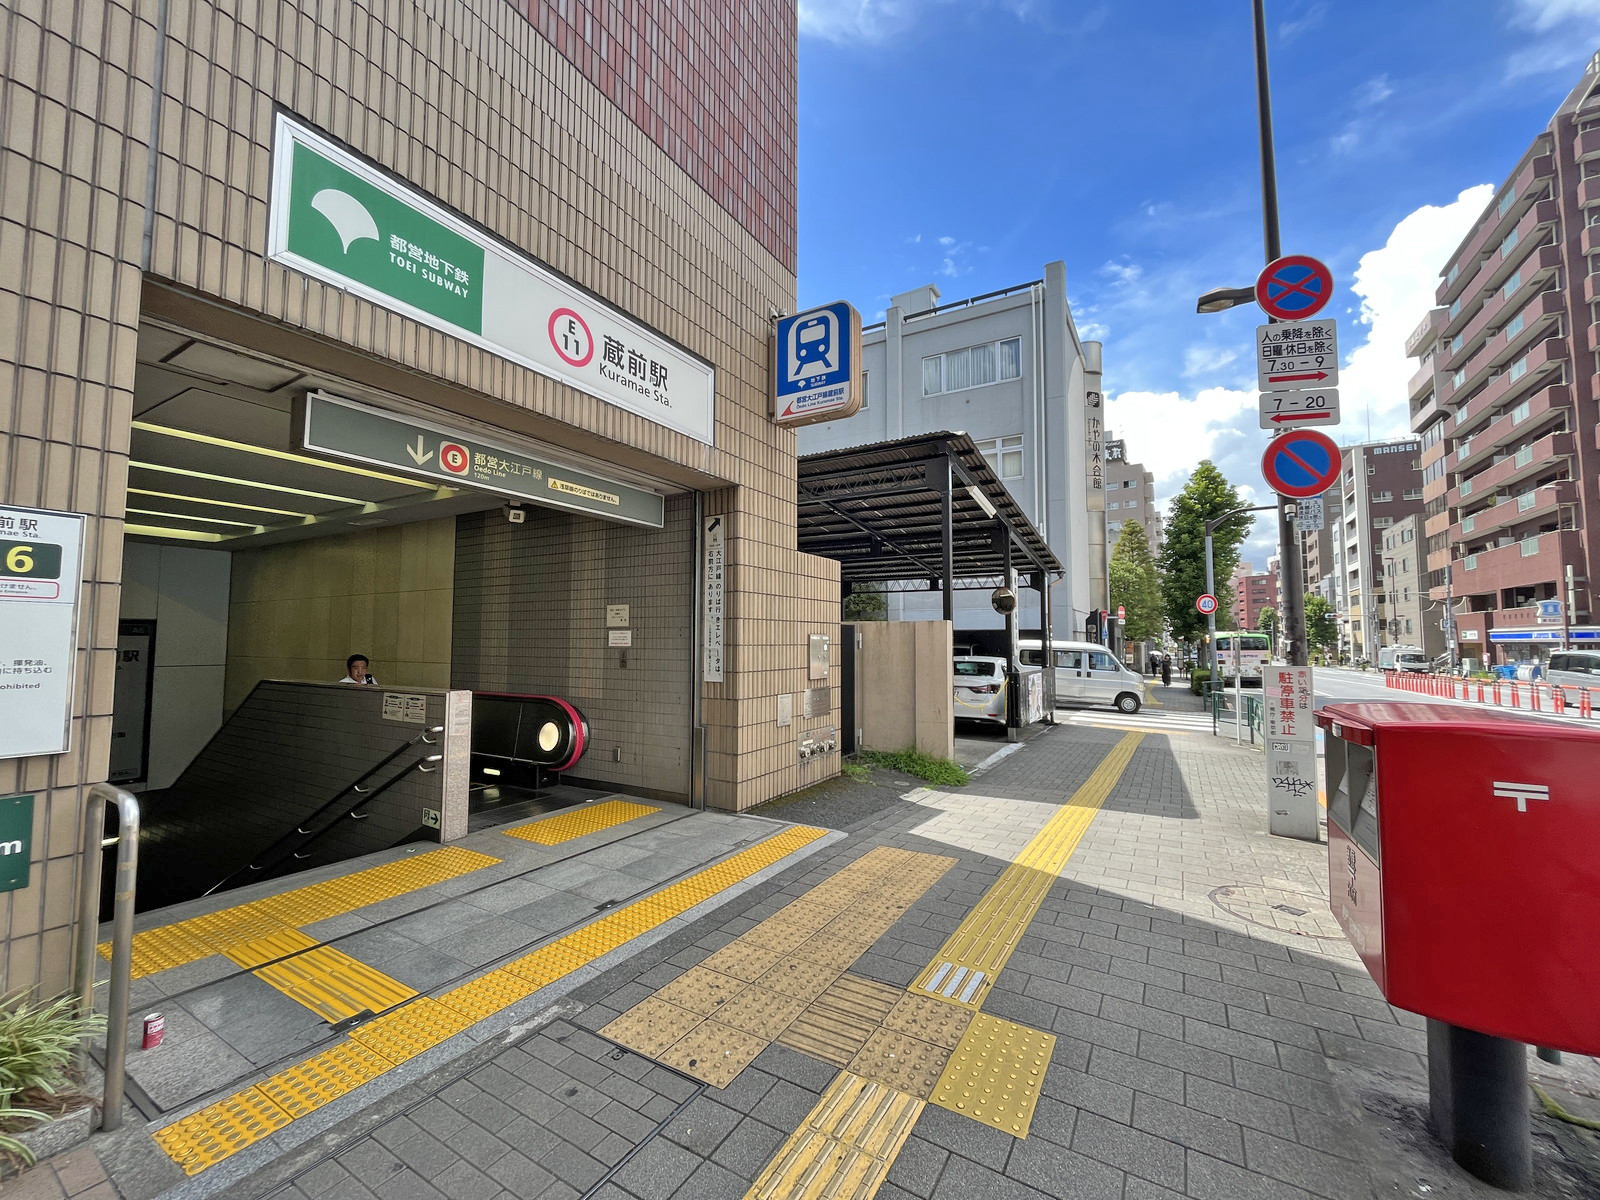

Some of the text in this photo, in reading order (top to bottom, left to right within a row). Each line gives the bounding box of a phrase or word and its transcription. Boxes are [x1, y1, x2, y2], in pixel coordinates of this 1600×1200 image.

[390, 233, 469, 286] 都営地下鉄
[389, 251, 469, 299] TOEI SUBWAY
[568, 318, 576, 336] E
[1261, 326, 1333, 343] 人の乗降を除く
[562, 333, 580, 356] 11
[1262, 341, 1333, 358] 日曜・休日を除く
[602, 334, 668, 392] 蔵前駅
[599, 362, 673, 408] Kuramae Sta.
[452, 453, 459, 464] E
[1091, 416, 1102, 490] かやの木会館
[473, 464, 507, 479] Oedo Line
[474, 452, 543, 481] 都営大江戸線
[474, 472, 490, 481] 120m
[22, 530, 42, 539] Sta.
[1201, 600, 1213, 609] 40
[1278, 671, 1297, 736] 駐停車禁止
